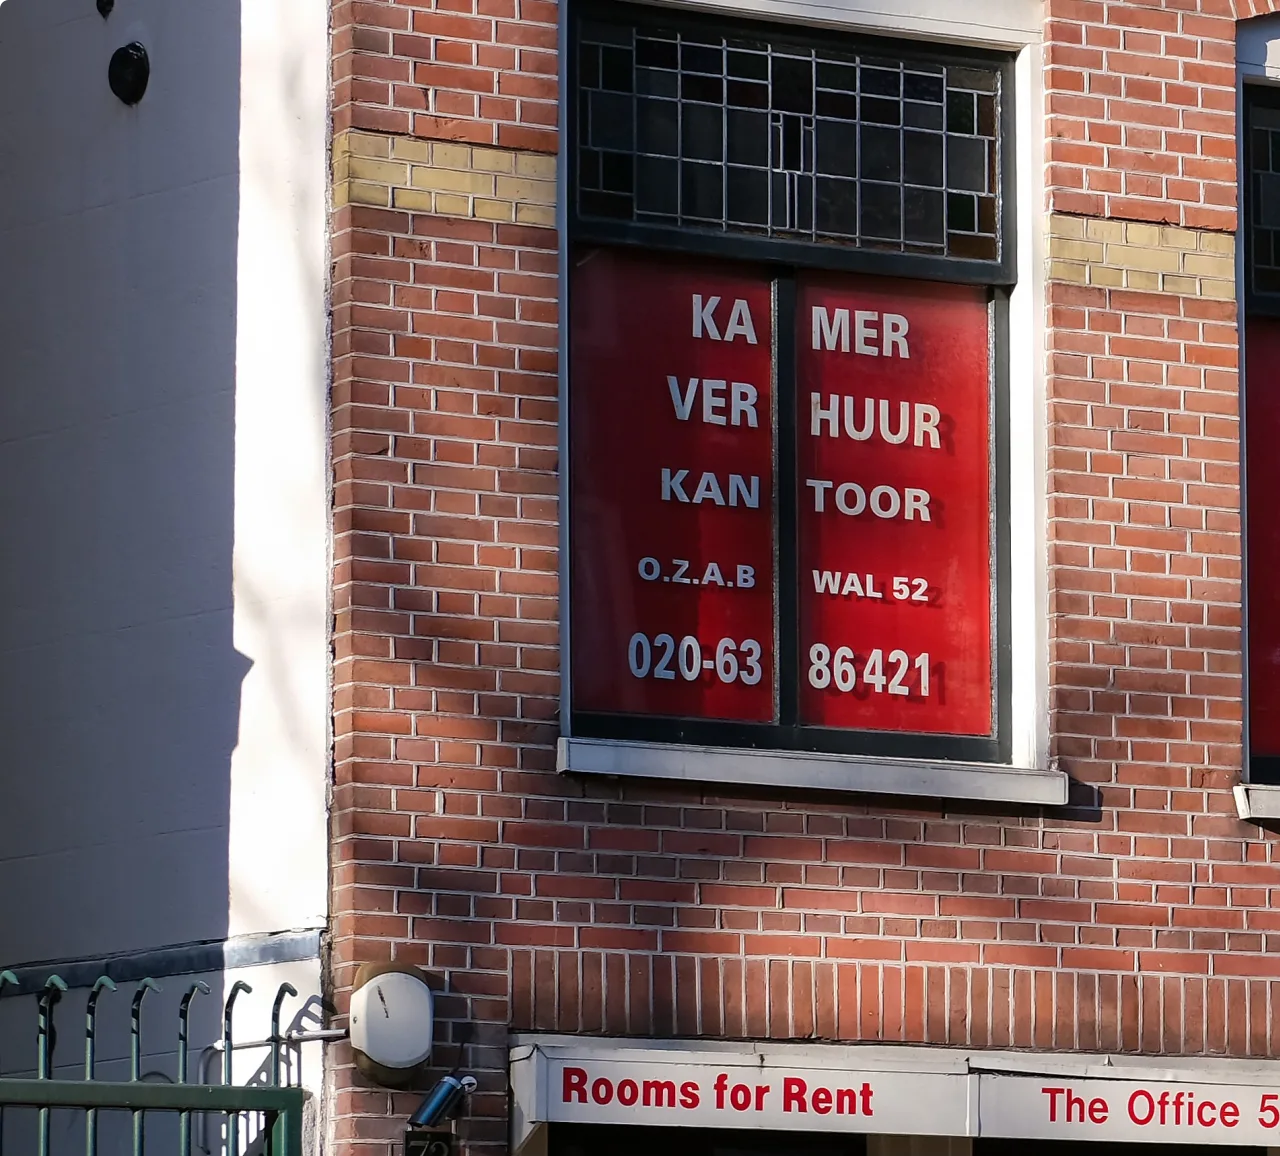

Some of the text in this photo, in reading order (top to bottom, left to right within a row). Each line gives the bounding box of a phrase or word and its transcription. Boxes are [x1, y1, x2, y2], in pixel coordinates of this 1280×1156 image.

[692, 294, 910, 359] KA MER
[667, 375, 941, 449] VER HUUR
[660, 467, 931, 522] KAN TOOR
[638, 556, 929, 602] O.Z.A.B WAL 52
[628, 632, 930, 697] 020-63 86421
[561, 1066, 874, 1117] Rooms for Rent
[1042, 1087, 1109, 1125] The
[1127, 1089, 1240, 1129] Office
